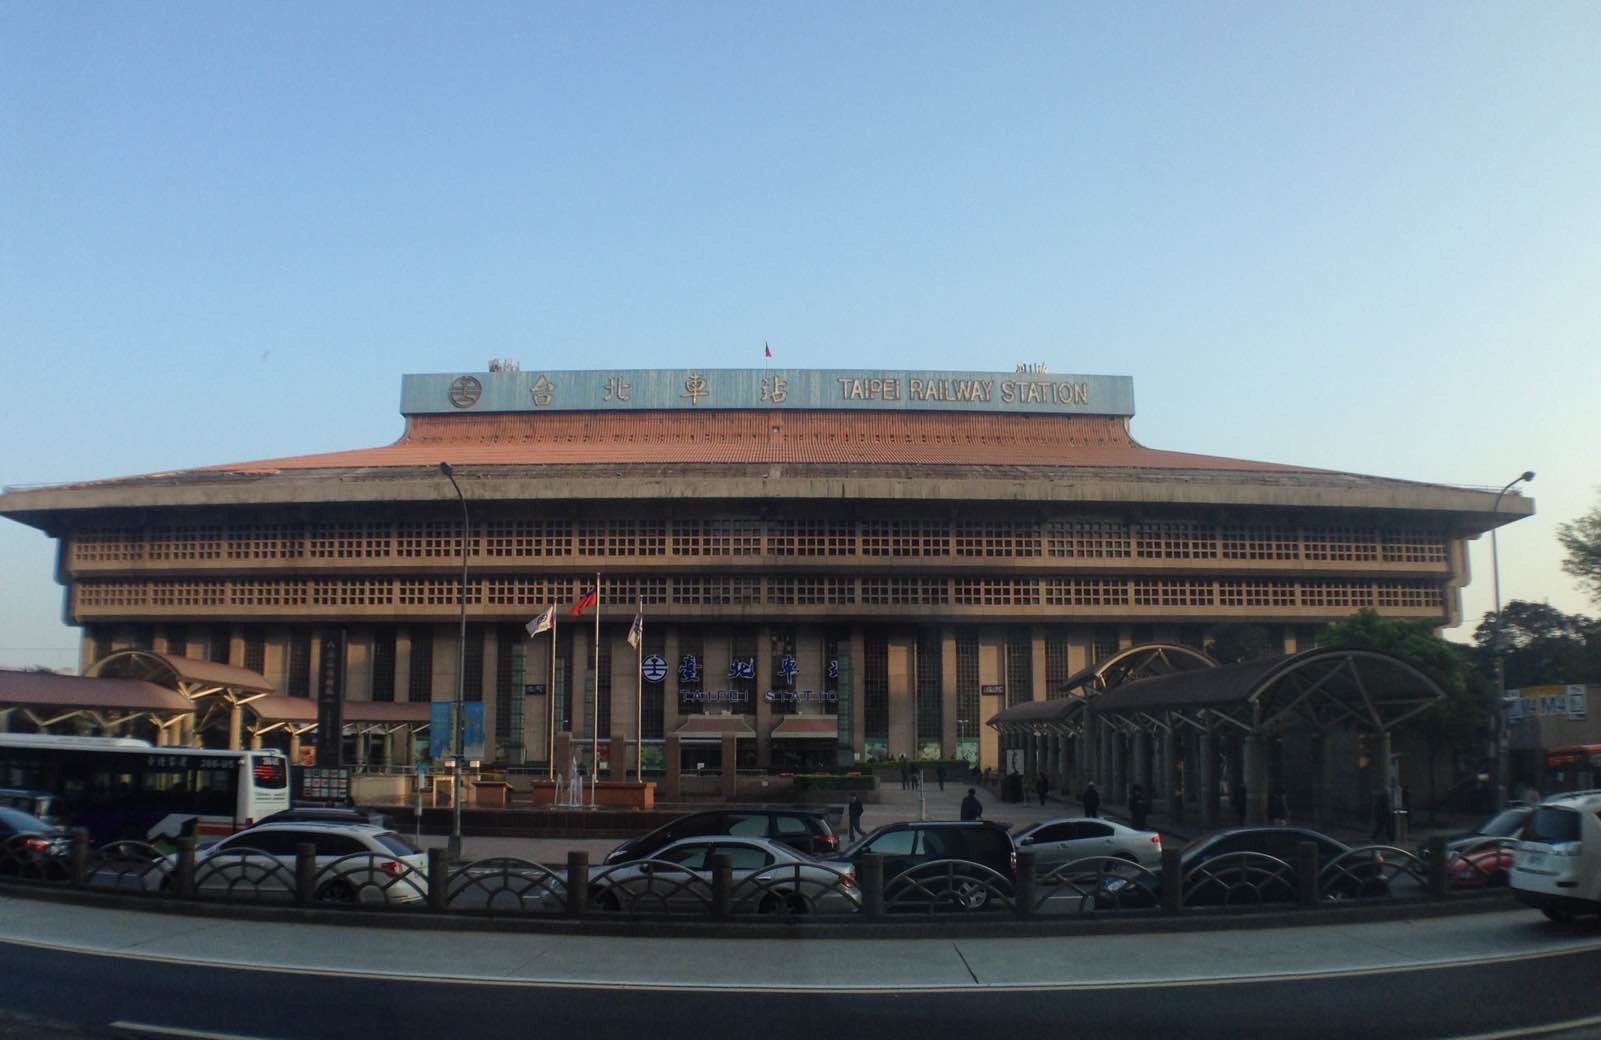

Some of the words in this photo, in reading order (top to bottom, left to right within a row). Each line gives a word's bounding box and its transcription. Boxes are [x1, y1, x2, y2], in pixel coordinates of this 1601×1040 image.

[838, 377, 901, 401] TAIPEI
[908, 378, 994, 402] RAILWAY
[1001, 380, 1089, 406] STATION
[680, 687, 749, 703] TAIPEI
[764, 687, 839, 703] STATIO
